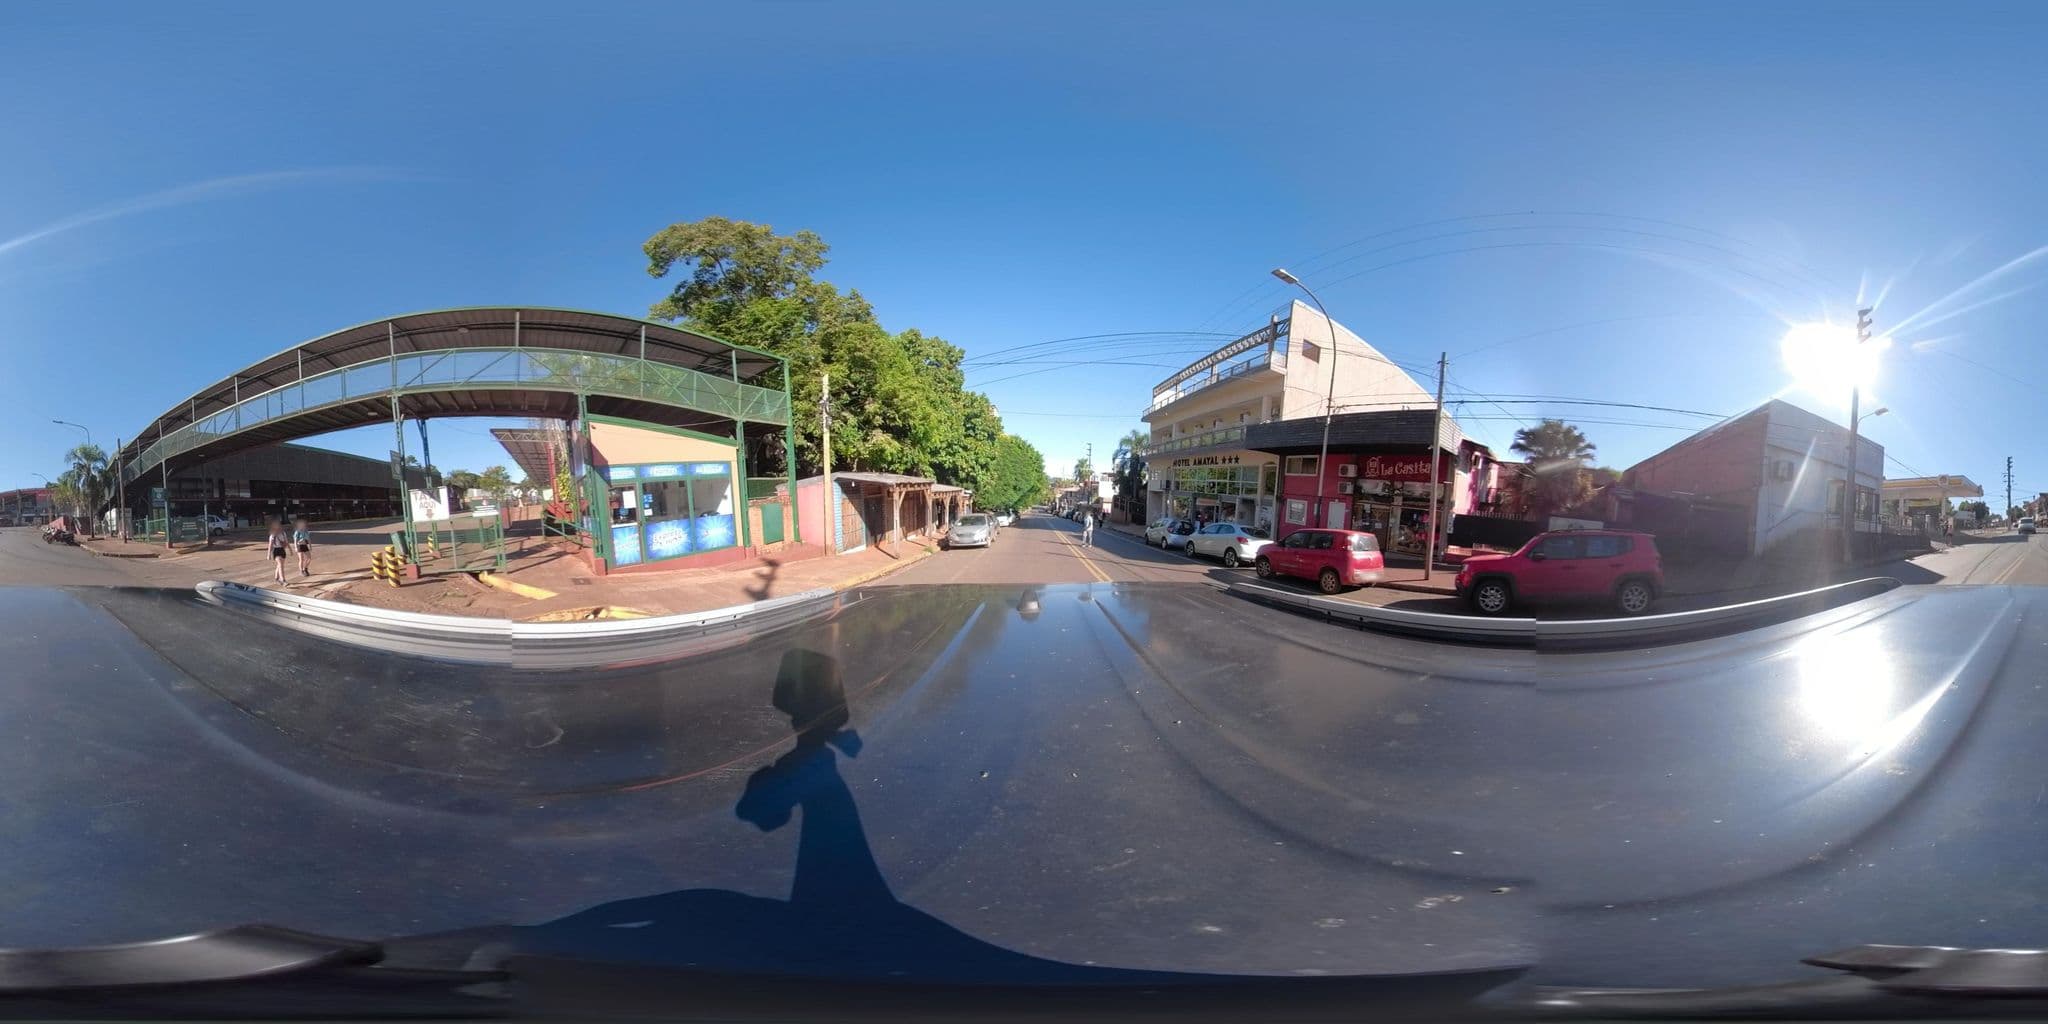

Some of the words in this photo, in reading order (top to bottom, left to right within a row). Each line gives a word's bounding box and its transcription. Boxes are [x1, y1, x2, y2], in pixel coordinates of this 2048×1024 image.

[1173, 458, 1190, 467] HOTEL
[1381, 463, 1393, 475] La
[1395, 461, 1431, 475] Casita
